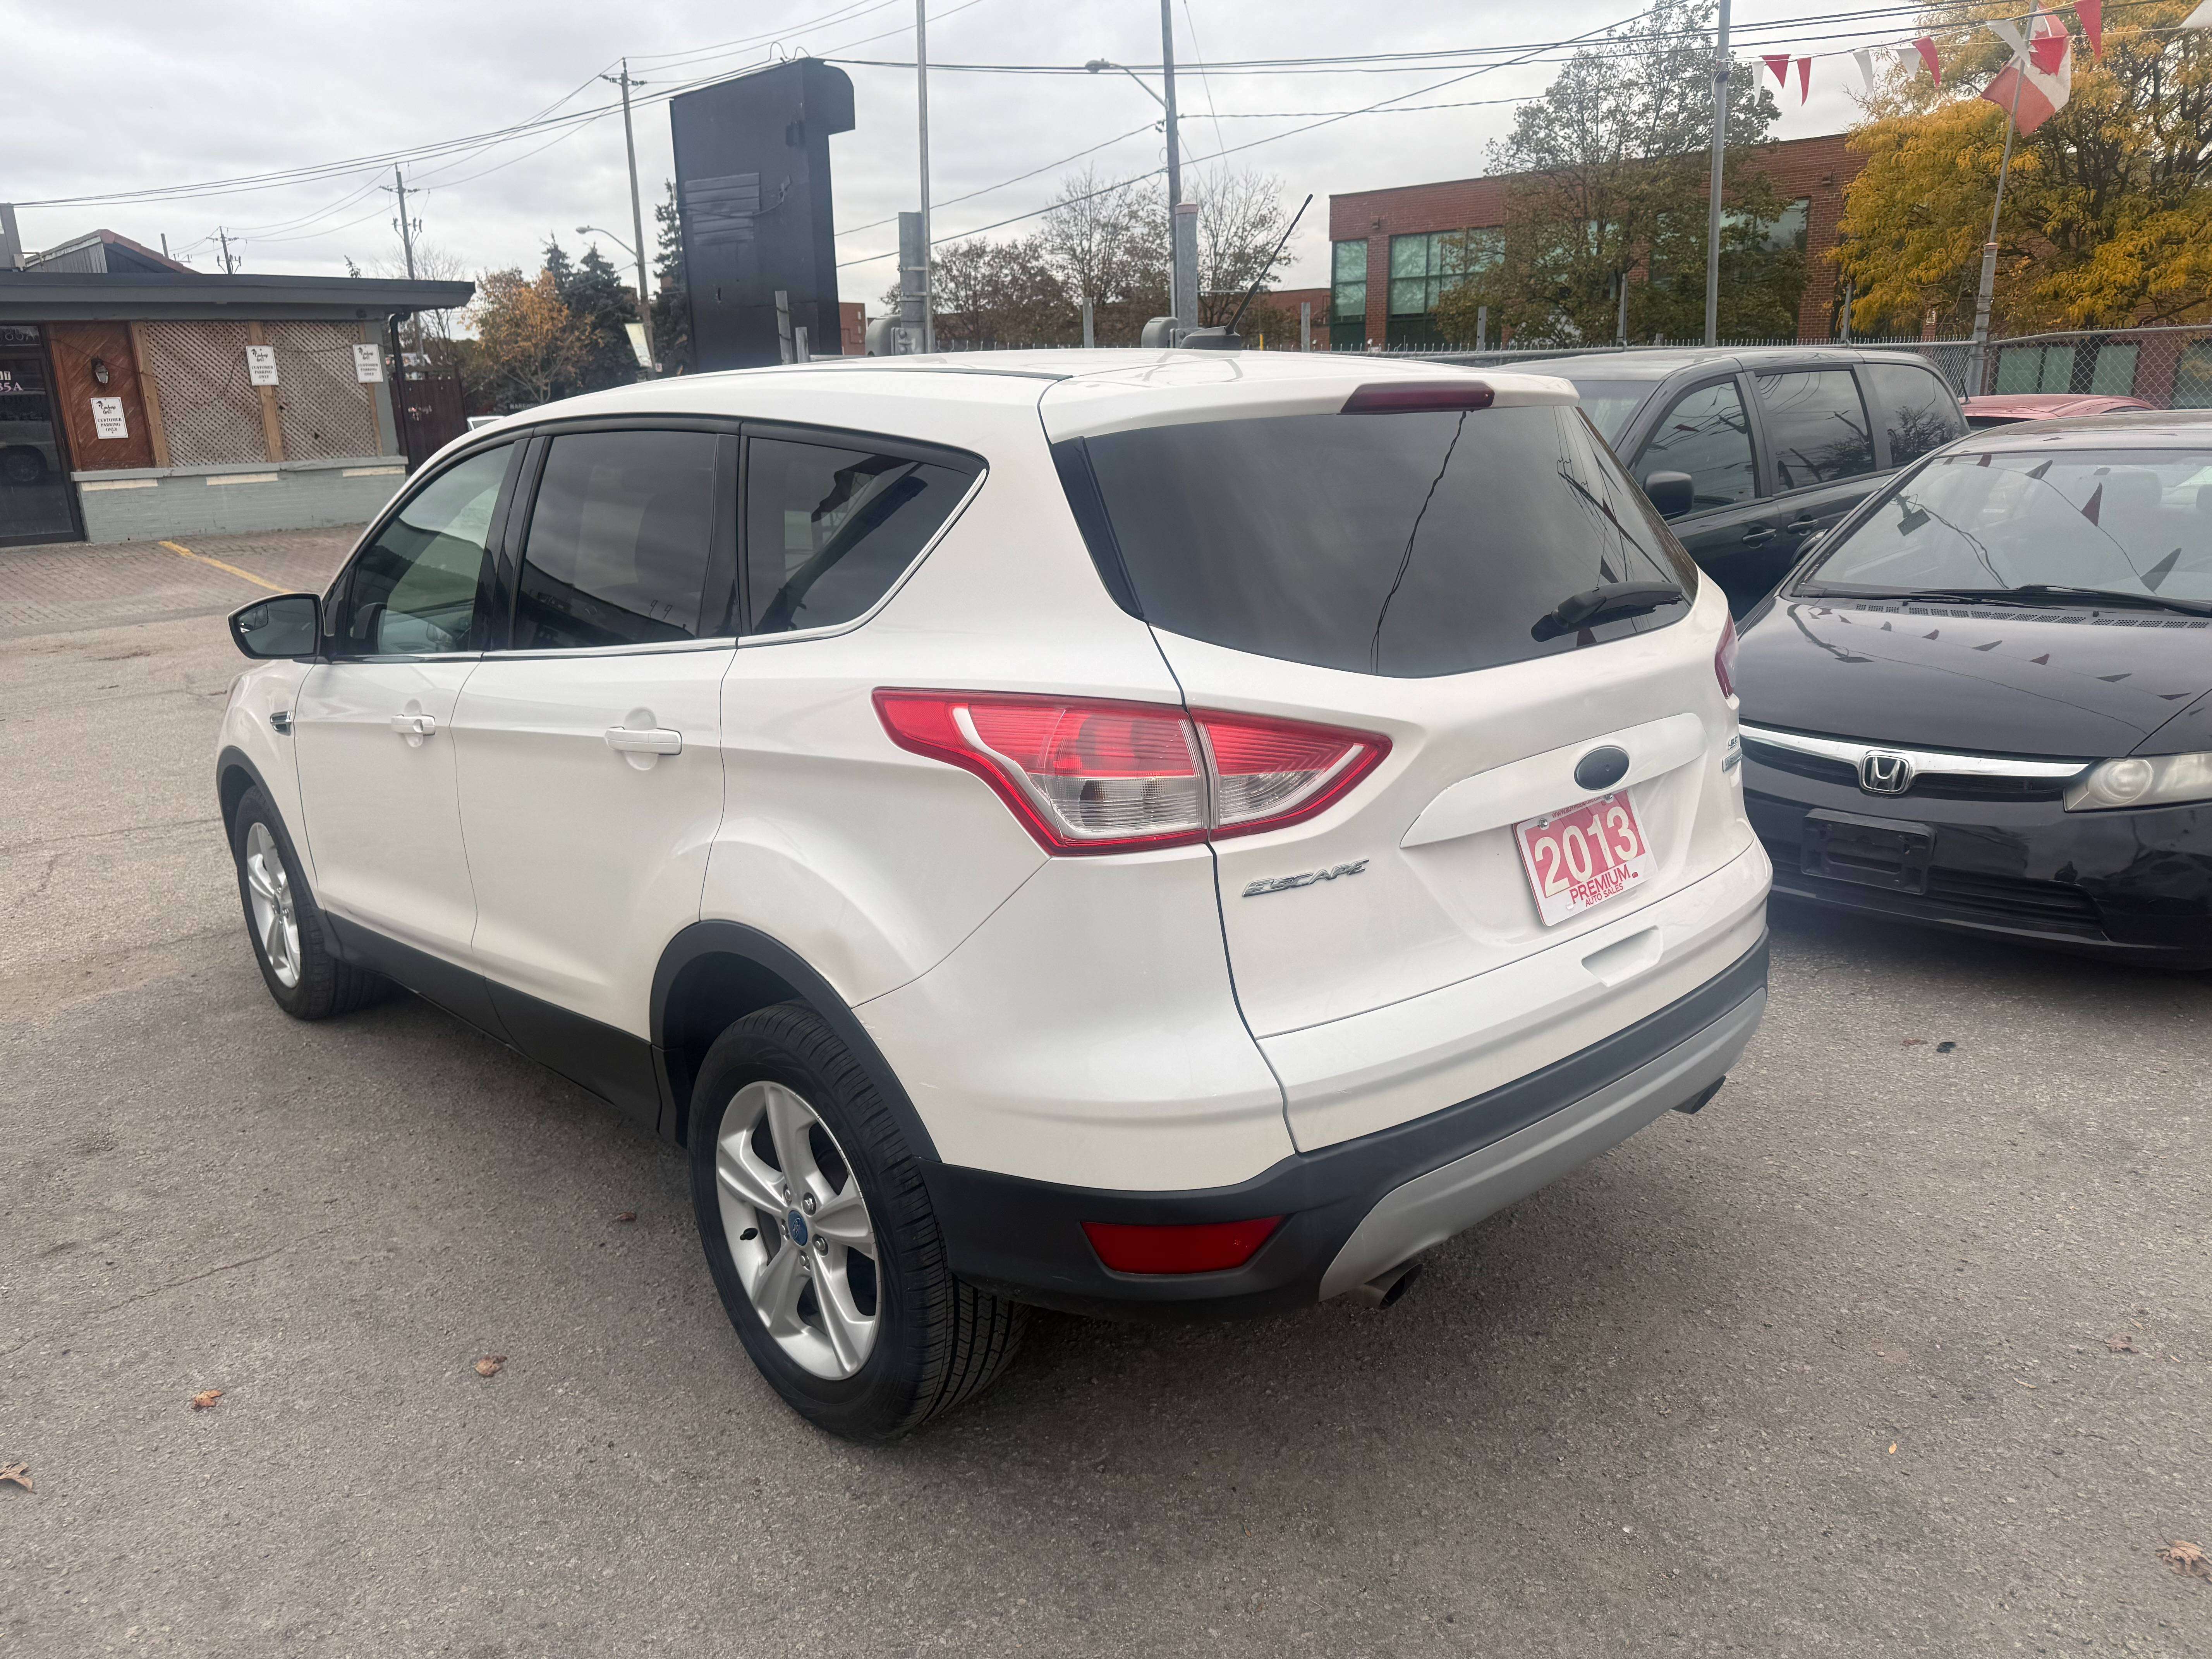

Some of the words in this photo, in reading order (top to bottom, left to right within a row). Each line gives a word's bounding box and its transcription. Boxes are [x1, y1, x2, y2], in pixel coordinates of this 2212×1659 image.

[1534, 806, 1638, 898] 2013
[1242, 858, 1370, 897] ESCAPE
[1569, 864, 1631, 904] PREMIUM
[1585, 893, 1602, 907] AUTO
[1604, 883, 1624, 902] SALES
